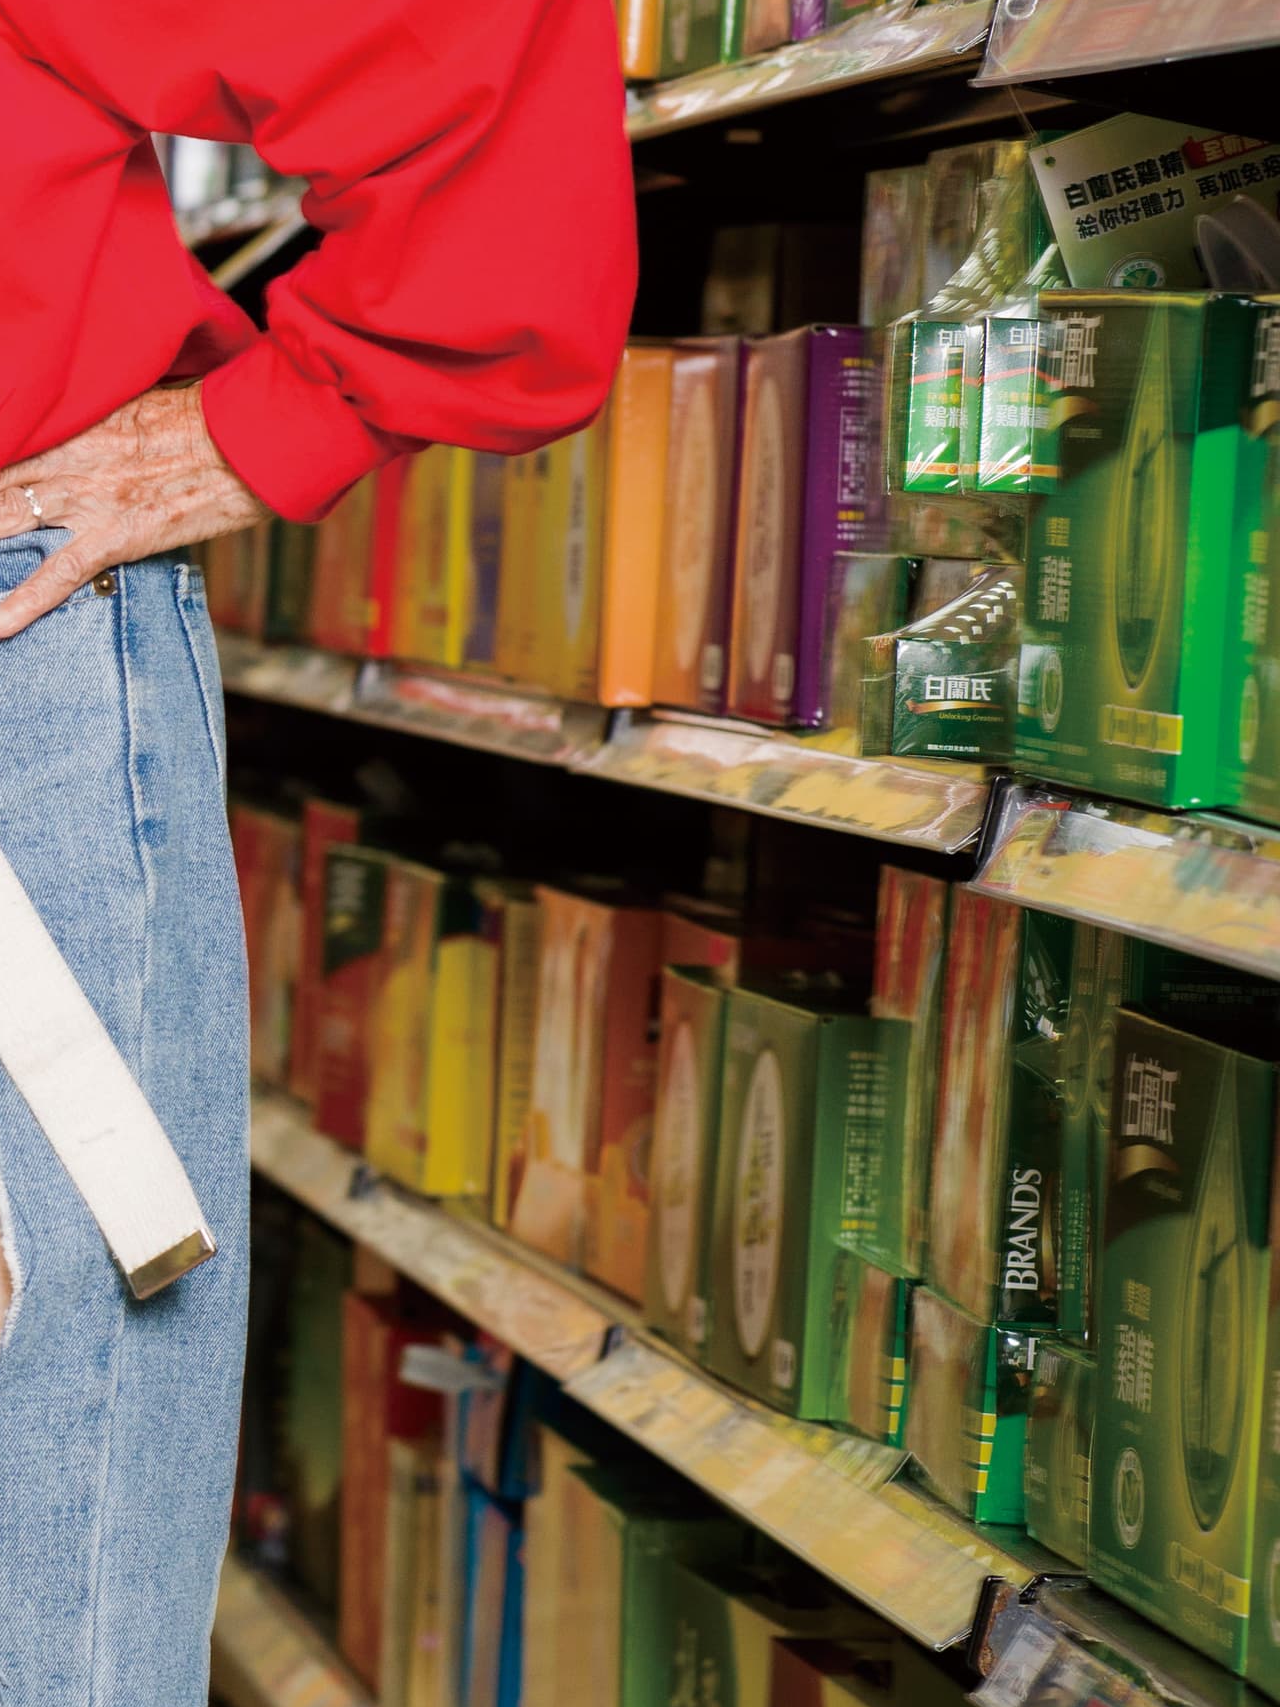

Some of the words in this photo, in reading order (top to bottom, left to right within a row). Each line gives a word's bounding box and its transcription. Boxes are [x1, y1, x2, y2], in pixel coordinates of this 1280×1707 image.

[1075, 186, 1186, 241] 給你好體力
[924, 674, 993, 701] 白蘭氏
